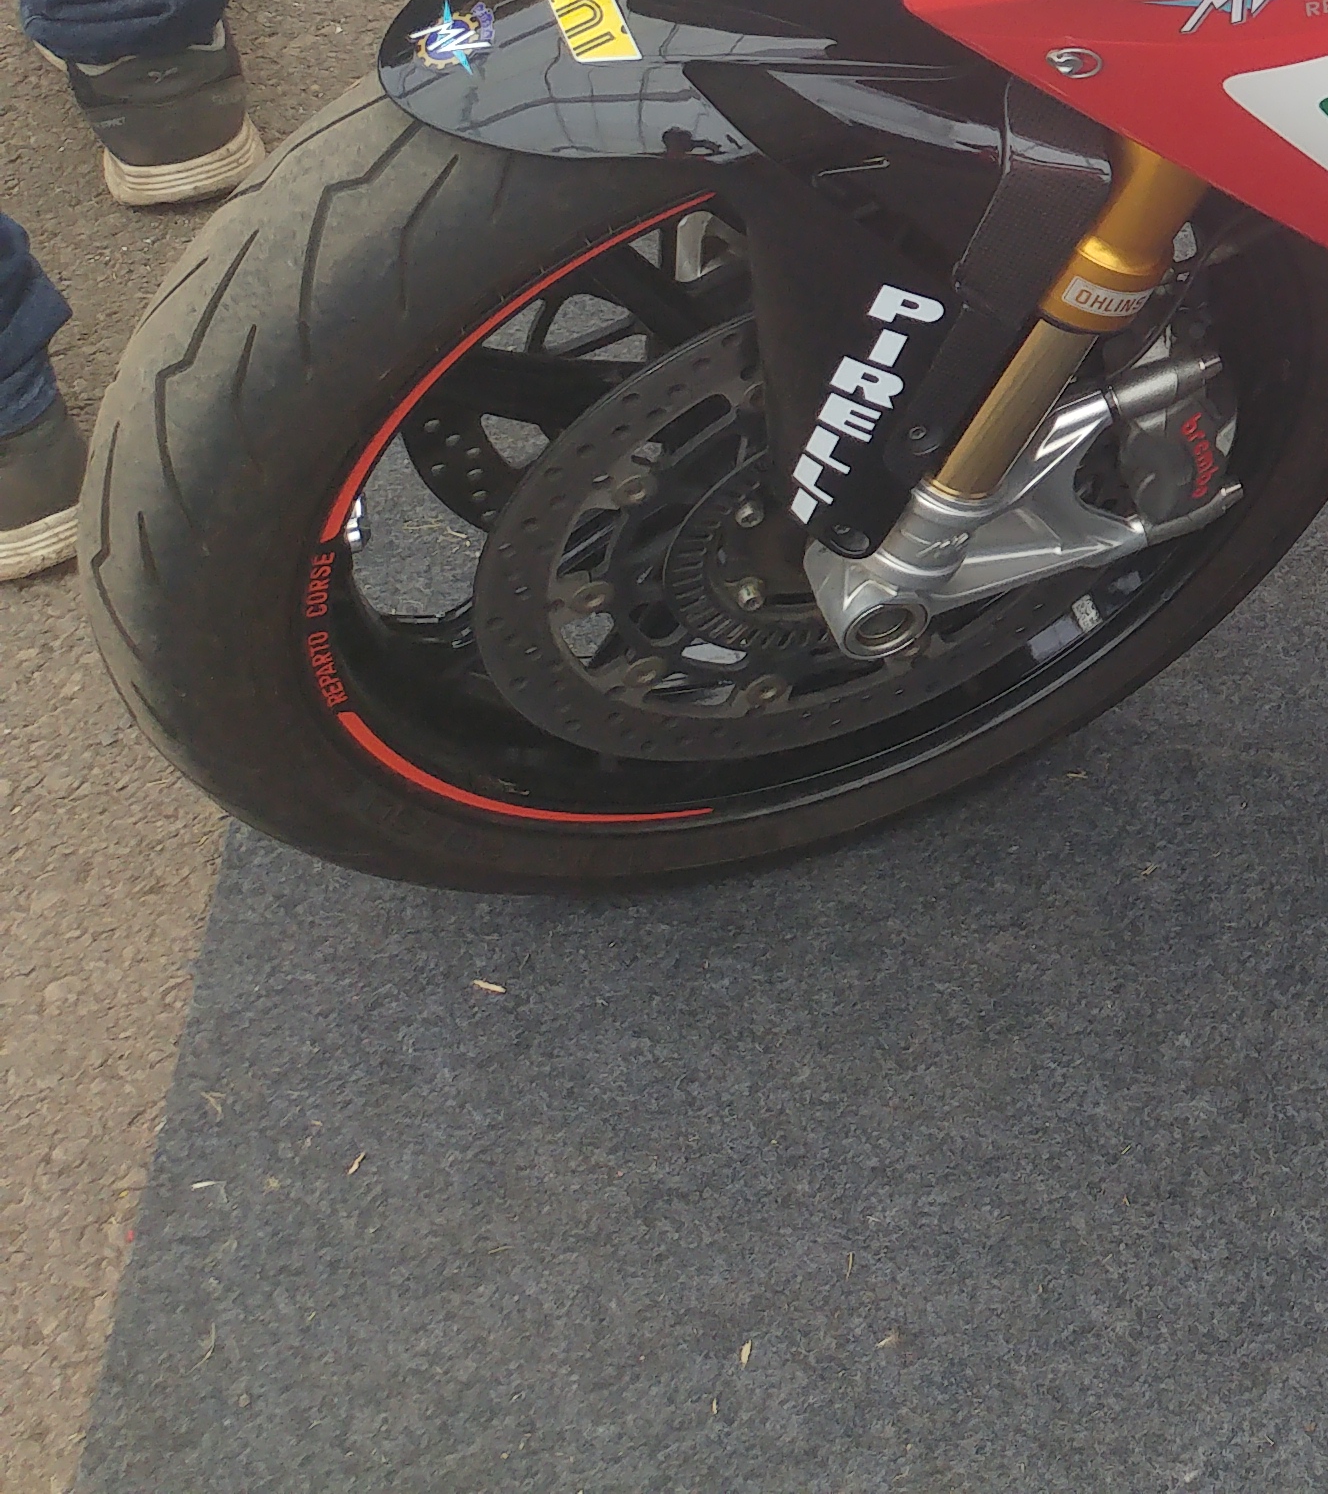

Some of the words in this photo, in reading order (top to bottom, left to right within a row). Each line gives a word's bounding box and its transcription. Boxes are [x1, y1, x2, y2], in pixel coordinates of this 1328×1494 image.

[790, 284, 945, 525] PIRELLI
[1180, 412, 1219, 499] brembo
[306, 551, 336, 618] CORSE
[307, 631, 349, 708] REPARTO
